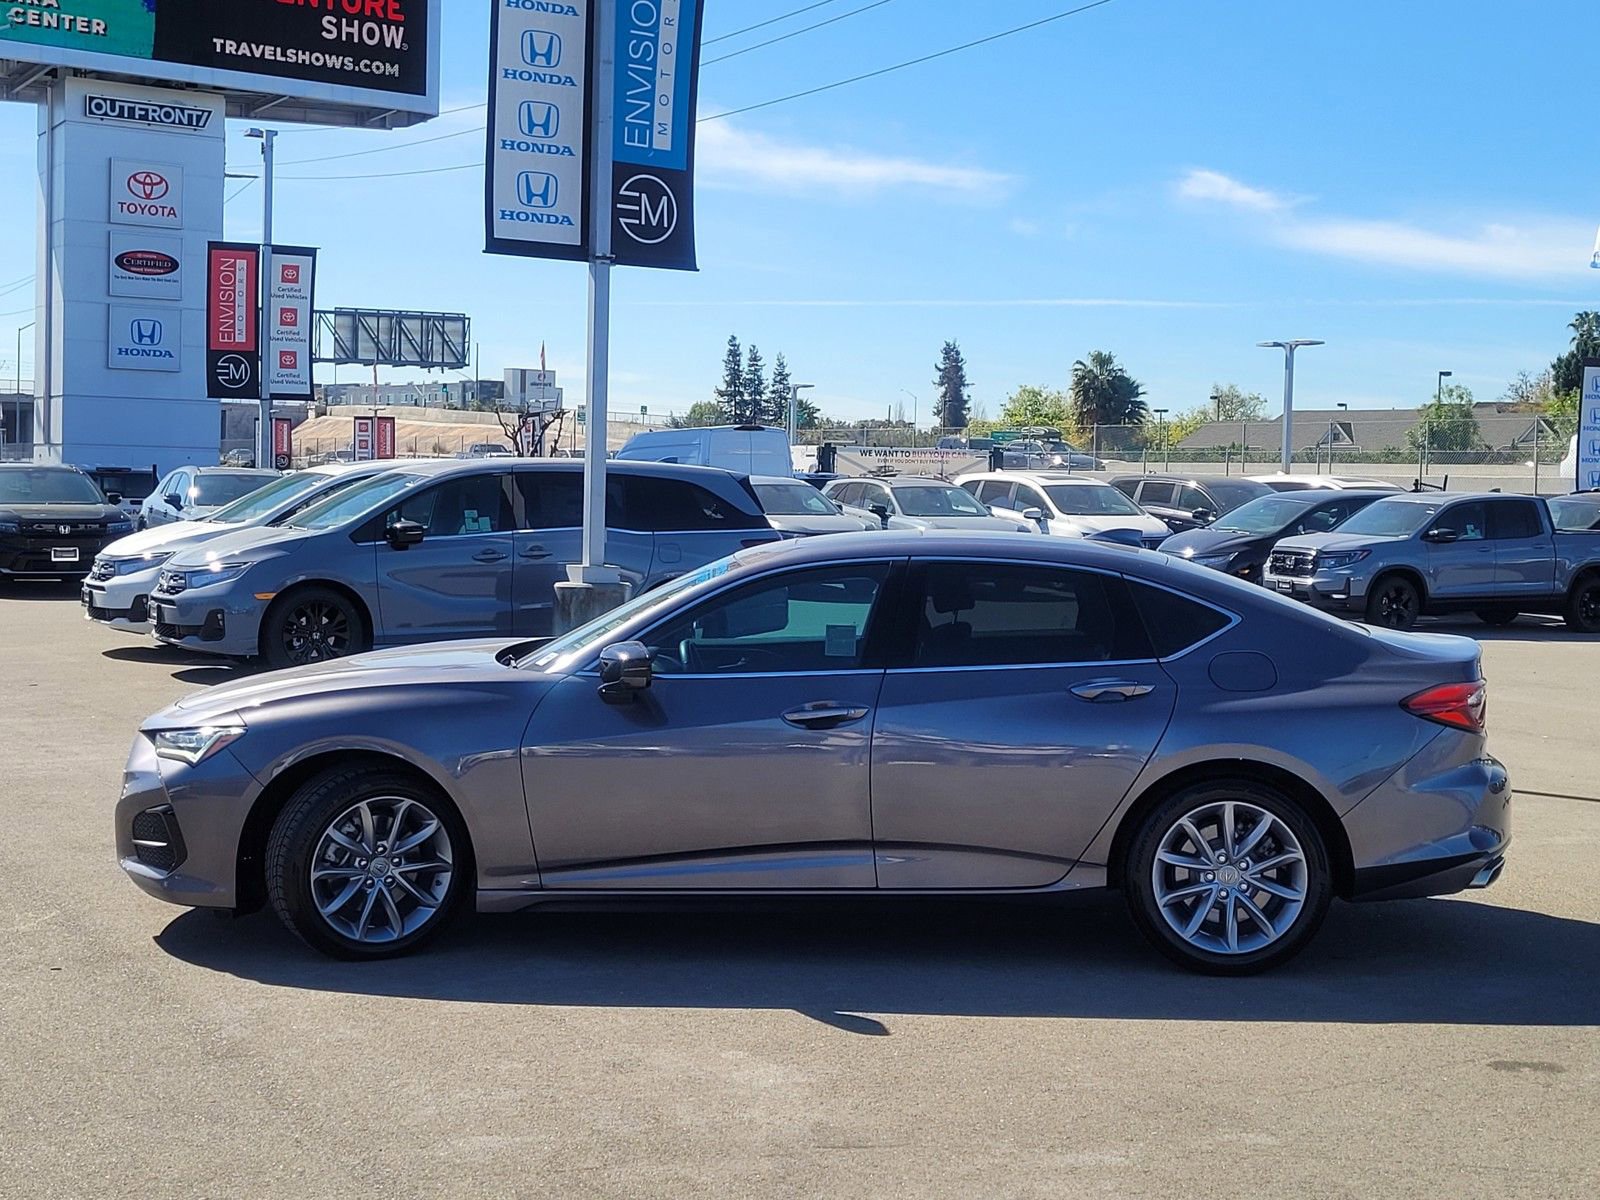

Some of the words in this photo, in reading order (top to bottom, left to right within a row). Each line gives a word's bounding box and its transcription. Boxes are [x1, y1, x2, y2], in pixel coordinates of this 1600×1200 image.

[505, 0, 580, 16] HONDA
[9, 7, 106, 35] CENTER
[213, 38, 400, 77] TRAVELSHOWS.COM
[657, 0, 678, 135] MOTOR
[502, 68, 577, 87] HONDA
[500, 139, 576, 157] HONDA
[117, 201, 178, 218] TOYOTA
[499, 209, 575, 226] HONDA
[219, 258, 235, 343] ENVISION
[237, 266, 245, 337] MOTORS
[117, 347, 174, 359] HONDA
[860, 449, 873, 457] WE
[874, 449, 899, 458] WANT
[900, 450, 911, 458] TO
[912, 450, 927, 458] BUY
[928, 451, 950, 459] YOUR
[951, 451, 967, 459] CAR
